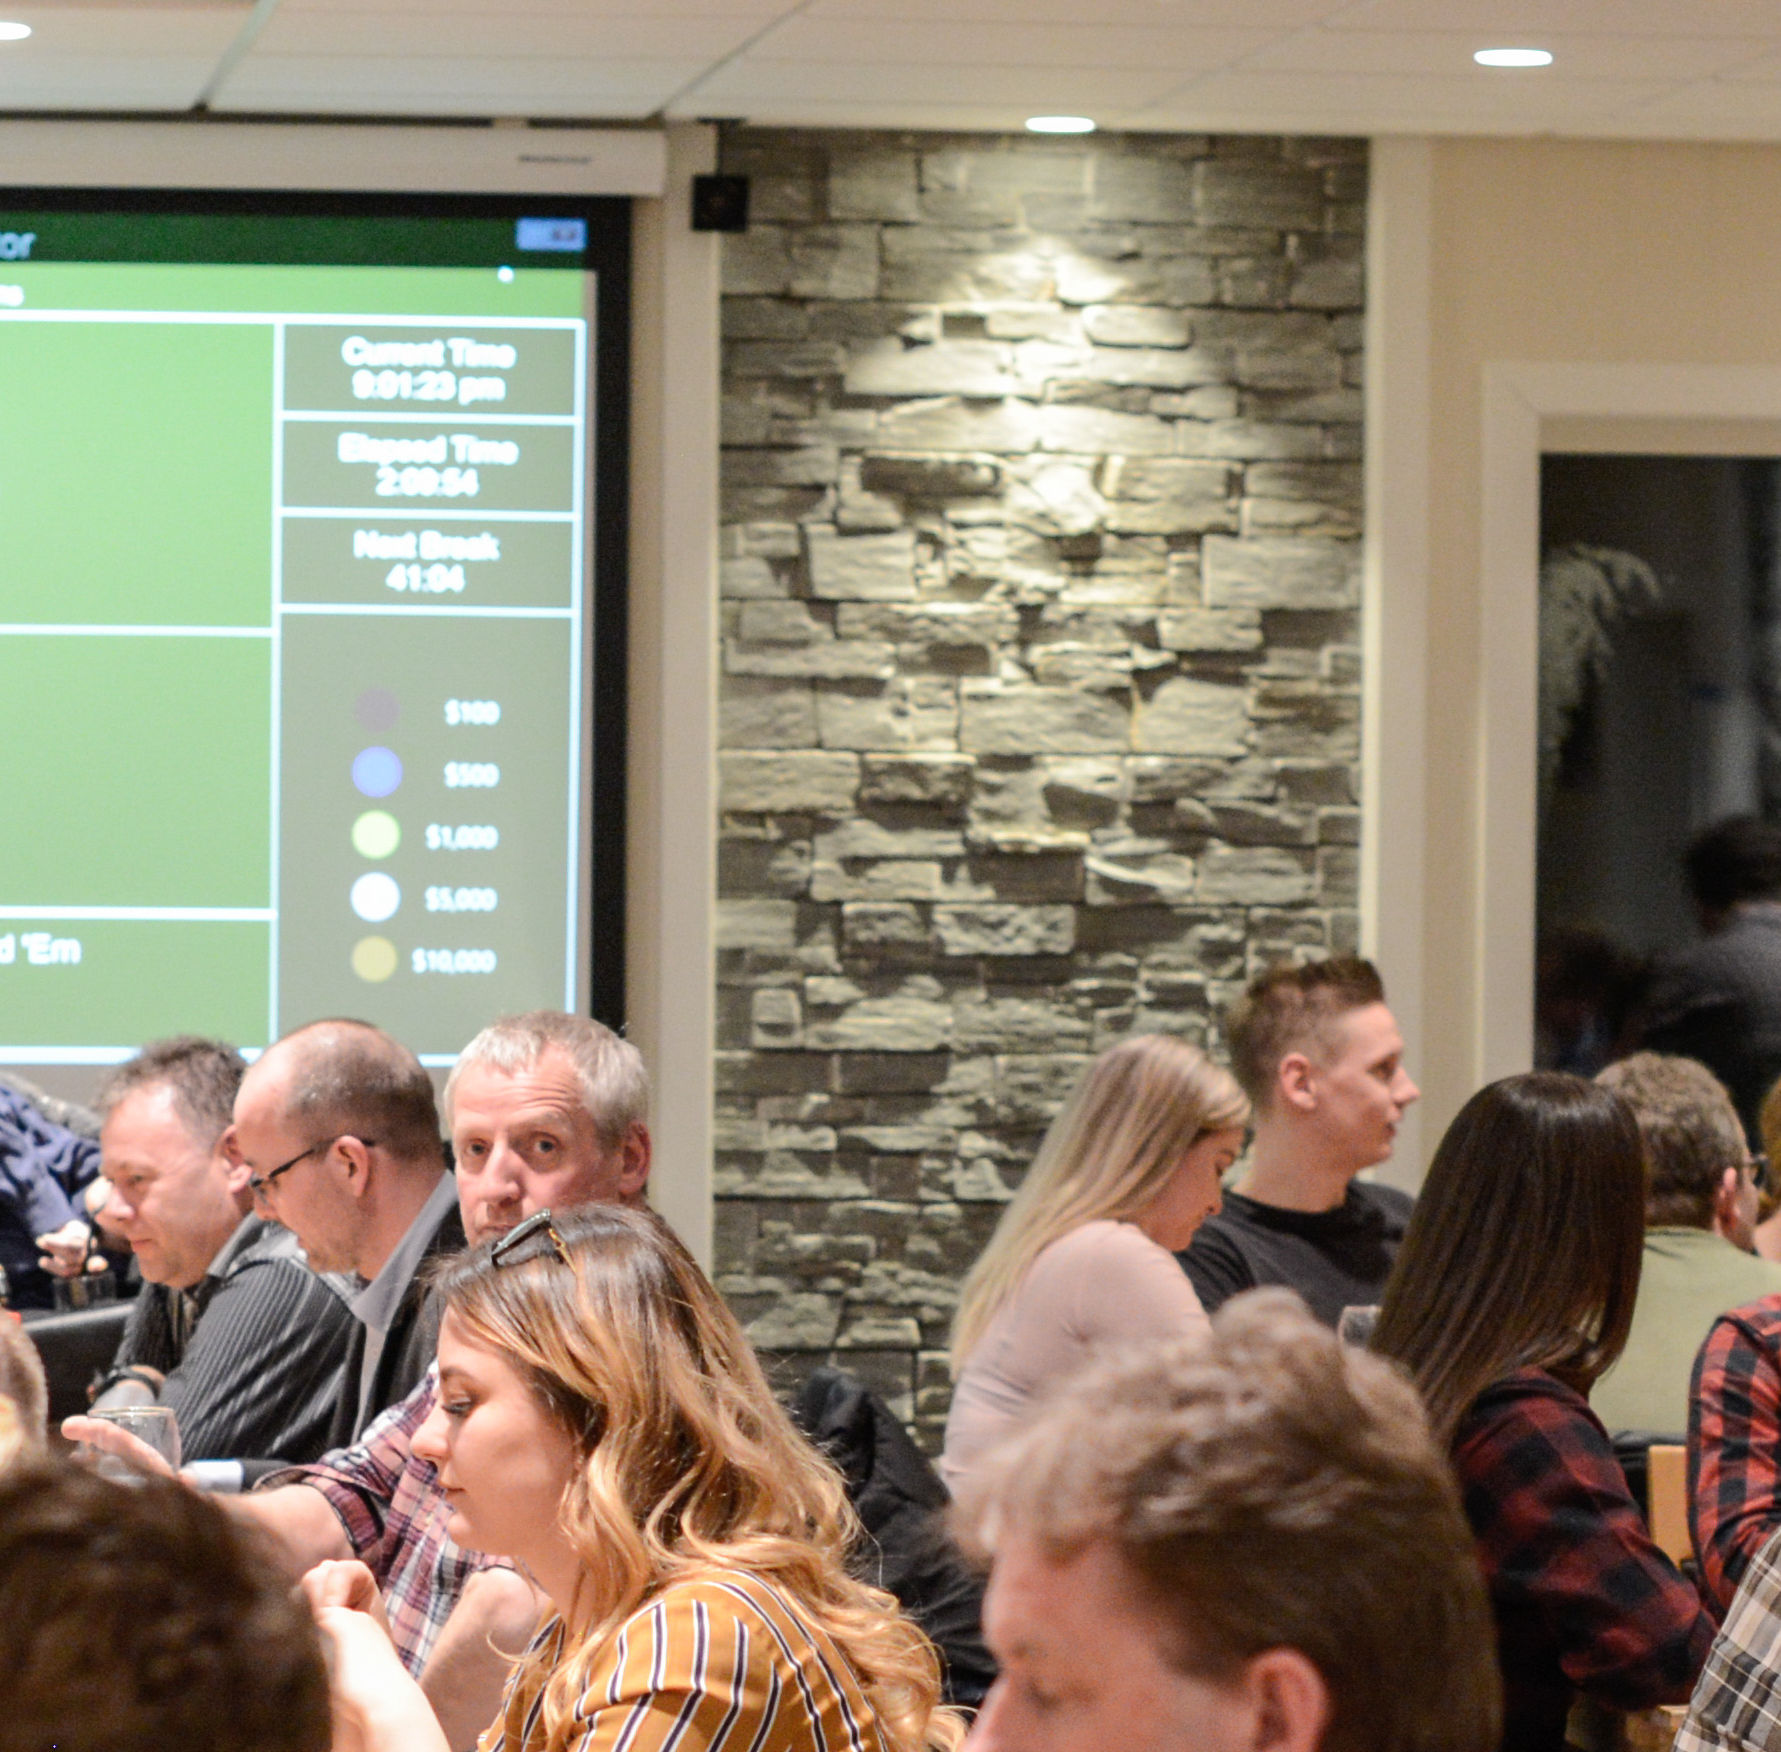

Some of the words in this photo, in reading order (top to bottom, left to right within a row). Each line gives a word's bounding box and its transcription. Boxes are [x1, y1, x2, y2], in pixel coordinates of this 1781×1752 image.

[342, 337, 445, 367] Current
[447, 338, 516, 369] Time
[458, 377, 506, 405] pm
[450, 434, 519, 465] Time
[353, 530, 417, 559] Next
[419, 531, 500, 561] Break
[385, 563, 465, 593] 41:04
